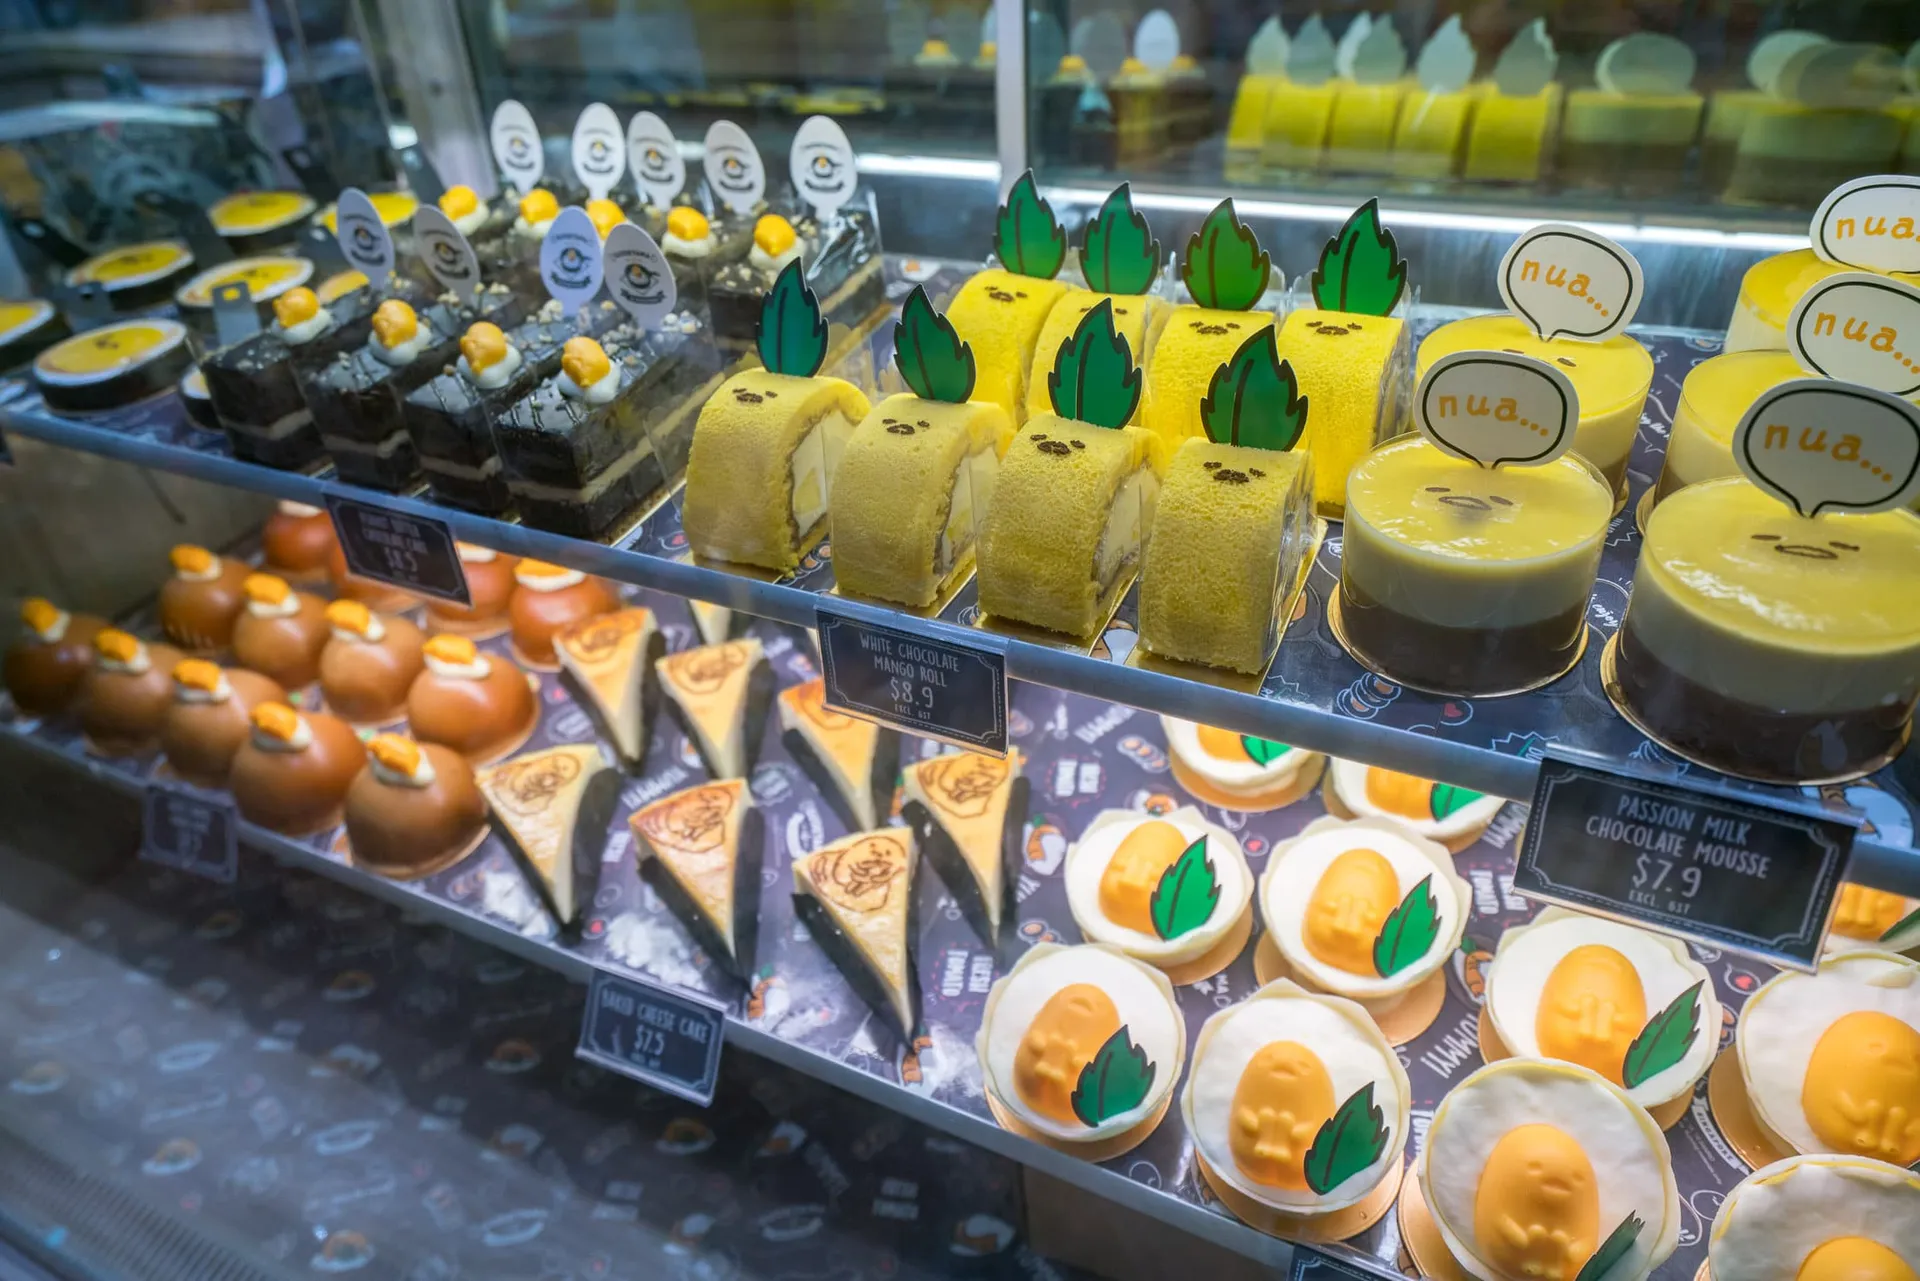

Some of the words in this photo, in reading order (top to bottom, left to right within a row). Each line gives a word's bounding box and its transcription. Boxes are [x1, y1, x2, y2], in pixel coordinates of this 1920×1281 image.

[1520, 260, 1609, 318] nua...
[1814, 312, 1920, 374] nua...
[1438, 395, 1549, 437] nua...
[1764, 424, 1892, 482] nua...
[859, 632, 892, 655] WHITE
[898, 644, 960, 673] CHOCOLATE
[874, 655, 915, 678] MANGO
[920, 668, 947, 688] ROLL
[890, 677, 934, 709] $8.9
[1617, 795, 1695, 830] PASSION
[1702, 816, 1752, 845] MILK
[1586, 816, 1685, 856] CHOCOLATE
[1693, 841, 1771, 879] MOUSSE
[1632, 853, 1702, 898] $7.9
